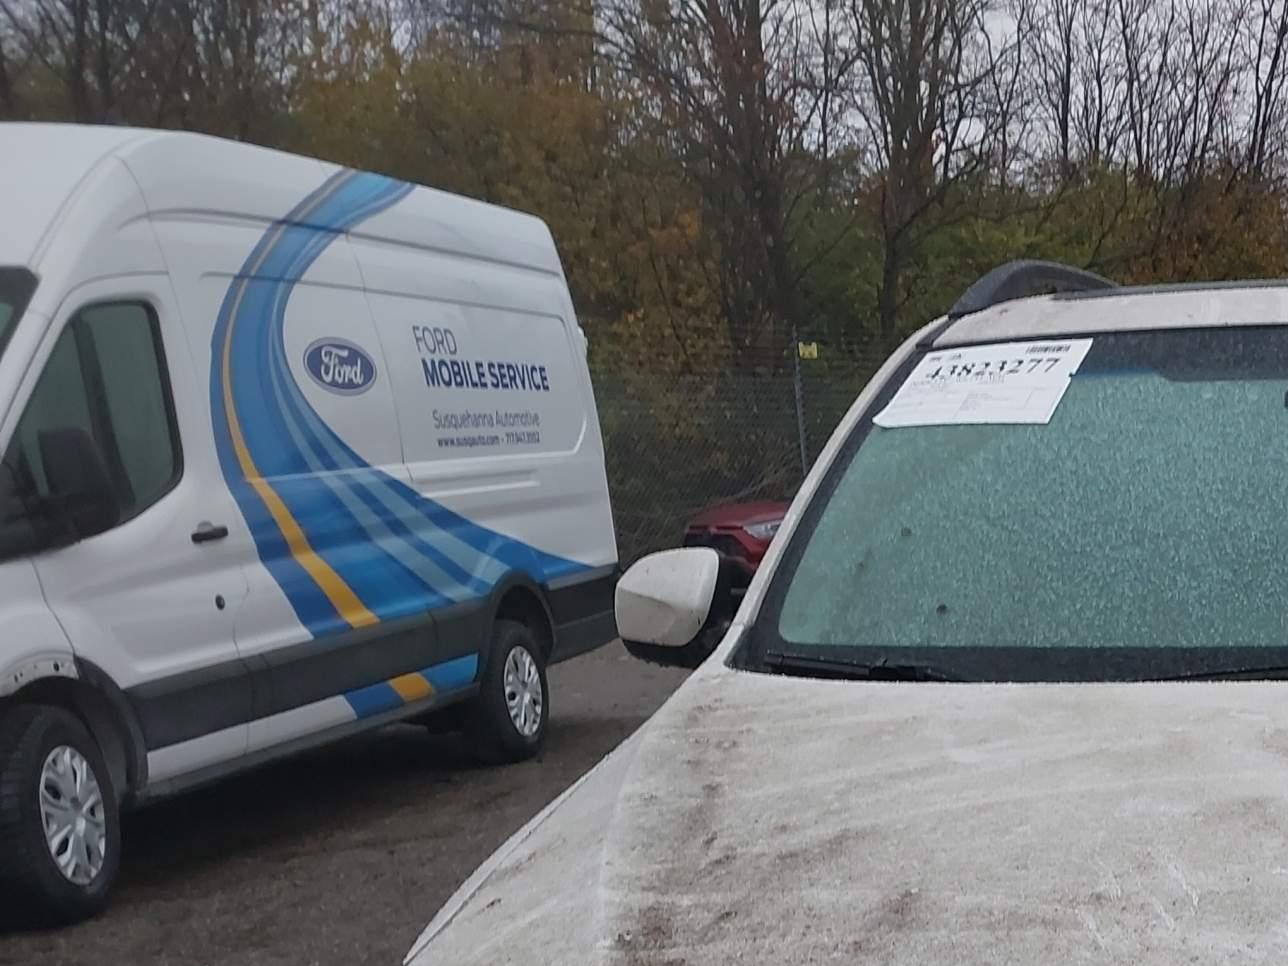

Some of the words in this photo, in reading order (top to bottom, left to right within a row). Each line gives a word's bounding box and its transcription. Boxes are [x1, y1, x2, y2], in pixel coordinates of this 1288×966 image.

[412, 325, 457, 355] FORD
[320, 345, 364, 385] Ford
[421, 357, 488, 390] MOBILE
[488, 361, 550, 391] SERVICE
[432, 408, 494, 430] Susquehanna
[496, 409, 540, 428] Automotive
